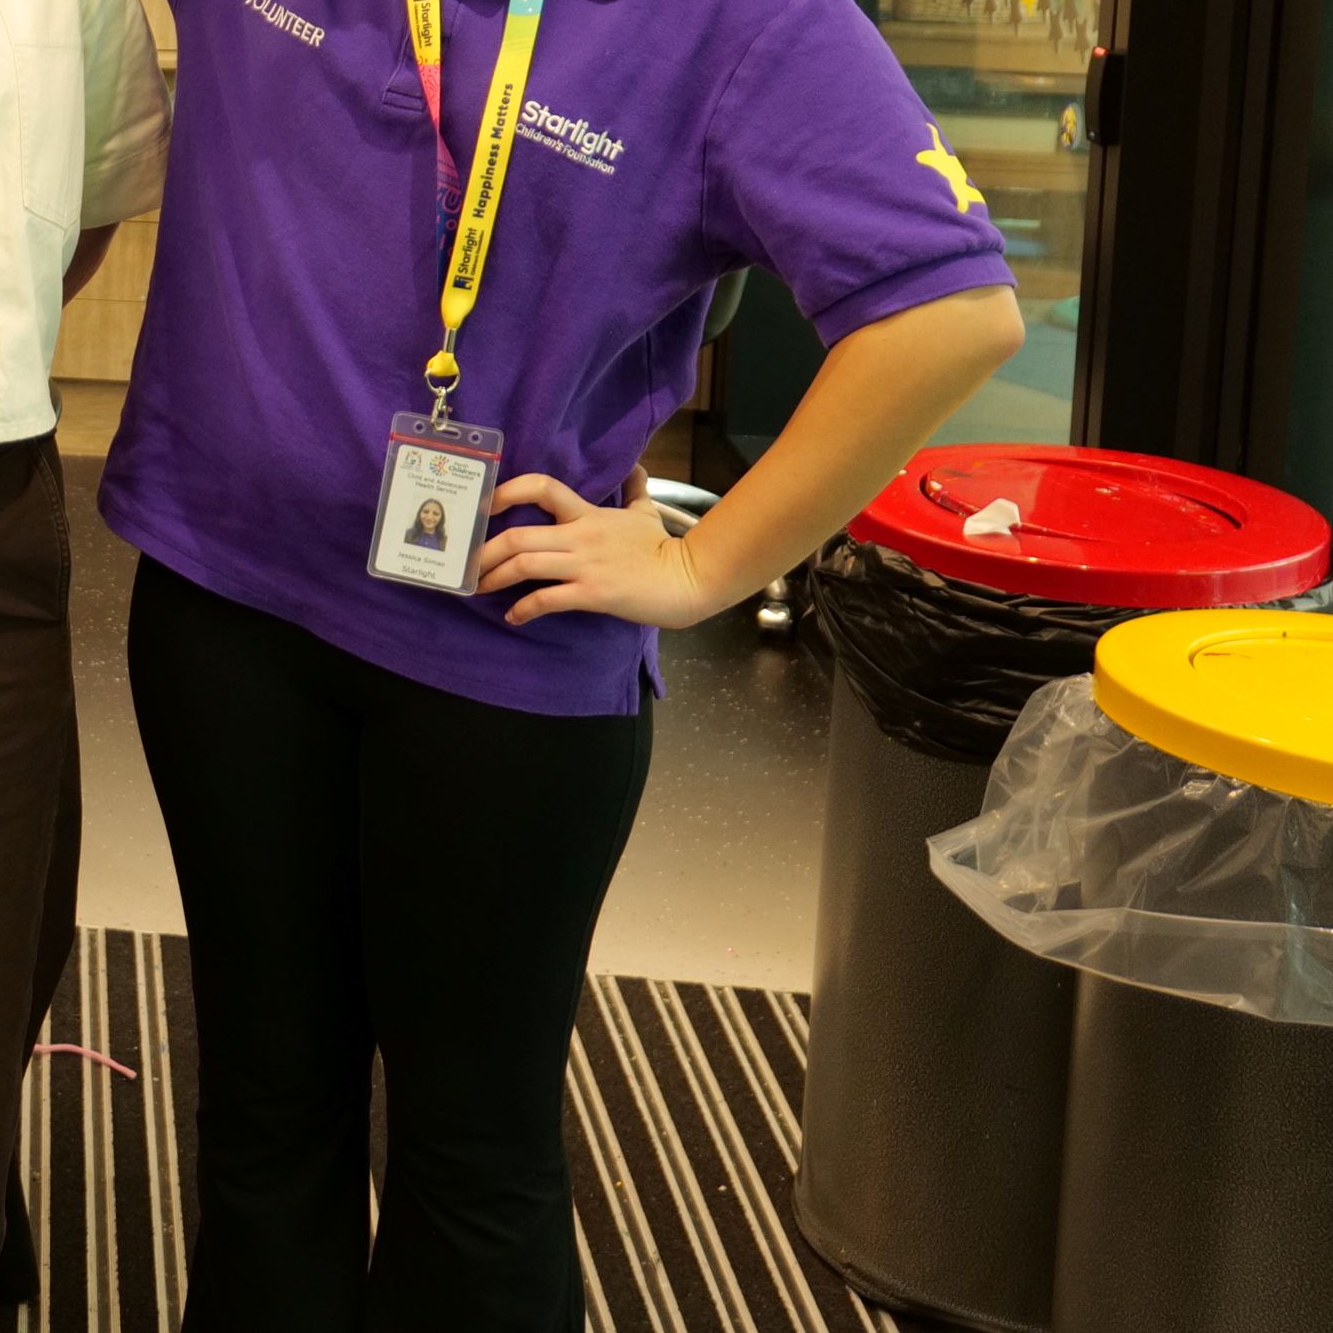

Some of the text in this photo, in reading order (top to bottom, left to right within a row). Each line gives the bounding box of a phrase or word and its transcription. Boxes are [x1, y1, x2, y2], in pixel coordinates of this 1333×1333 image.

[421, 2, 433, 47] Starlight
[473, 82, 514, 218] Happiness Matters
[515, 122, 615, 175] Children's Foundation
[522, 100, 625, 161] Starlight
[457, 227, 477, 274] Starlight
